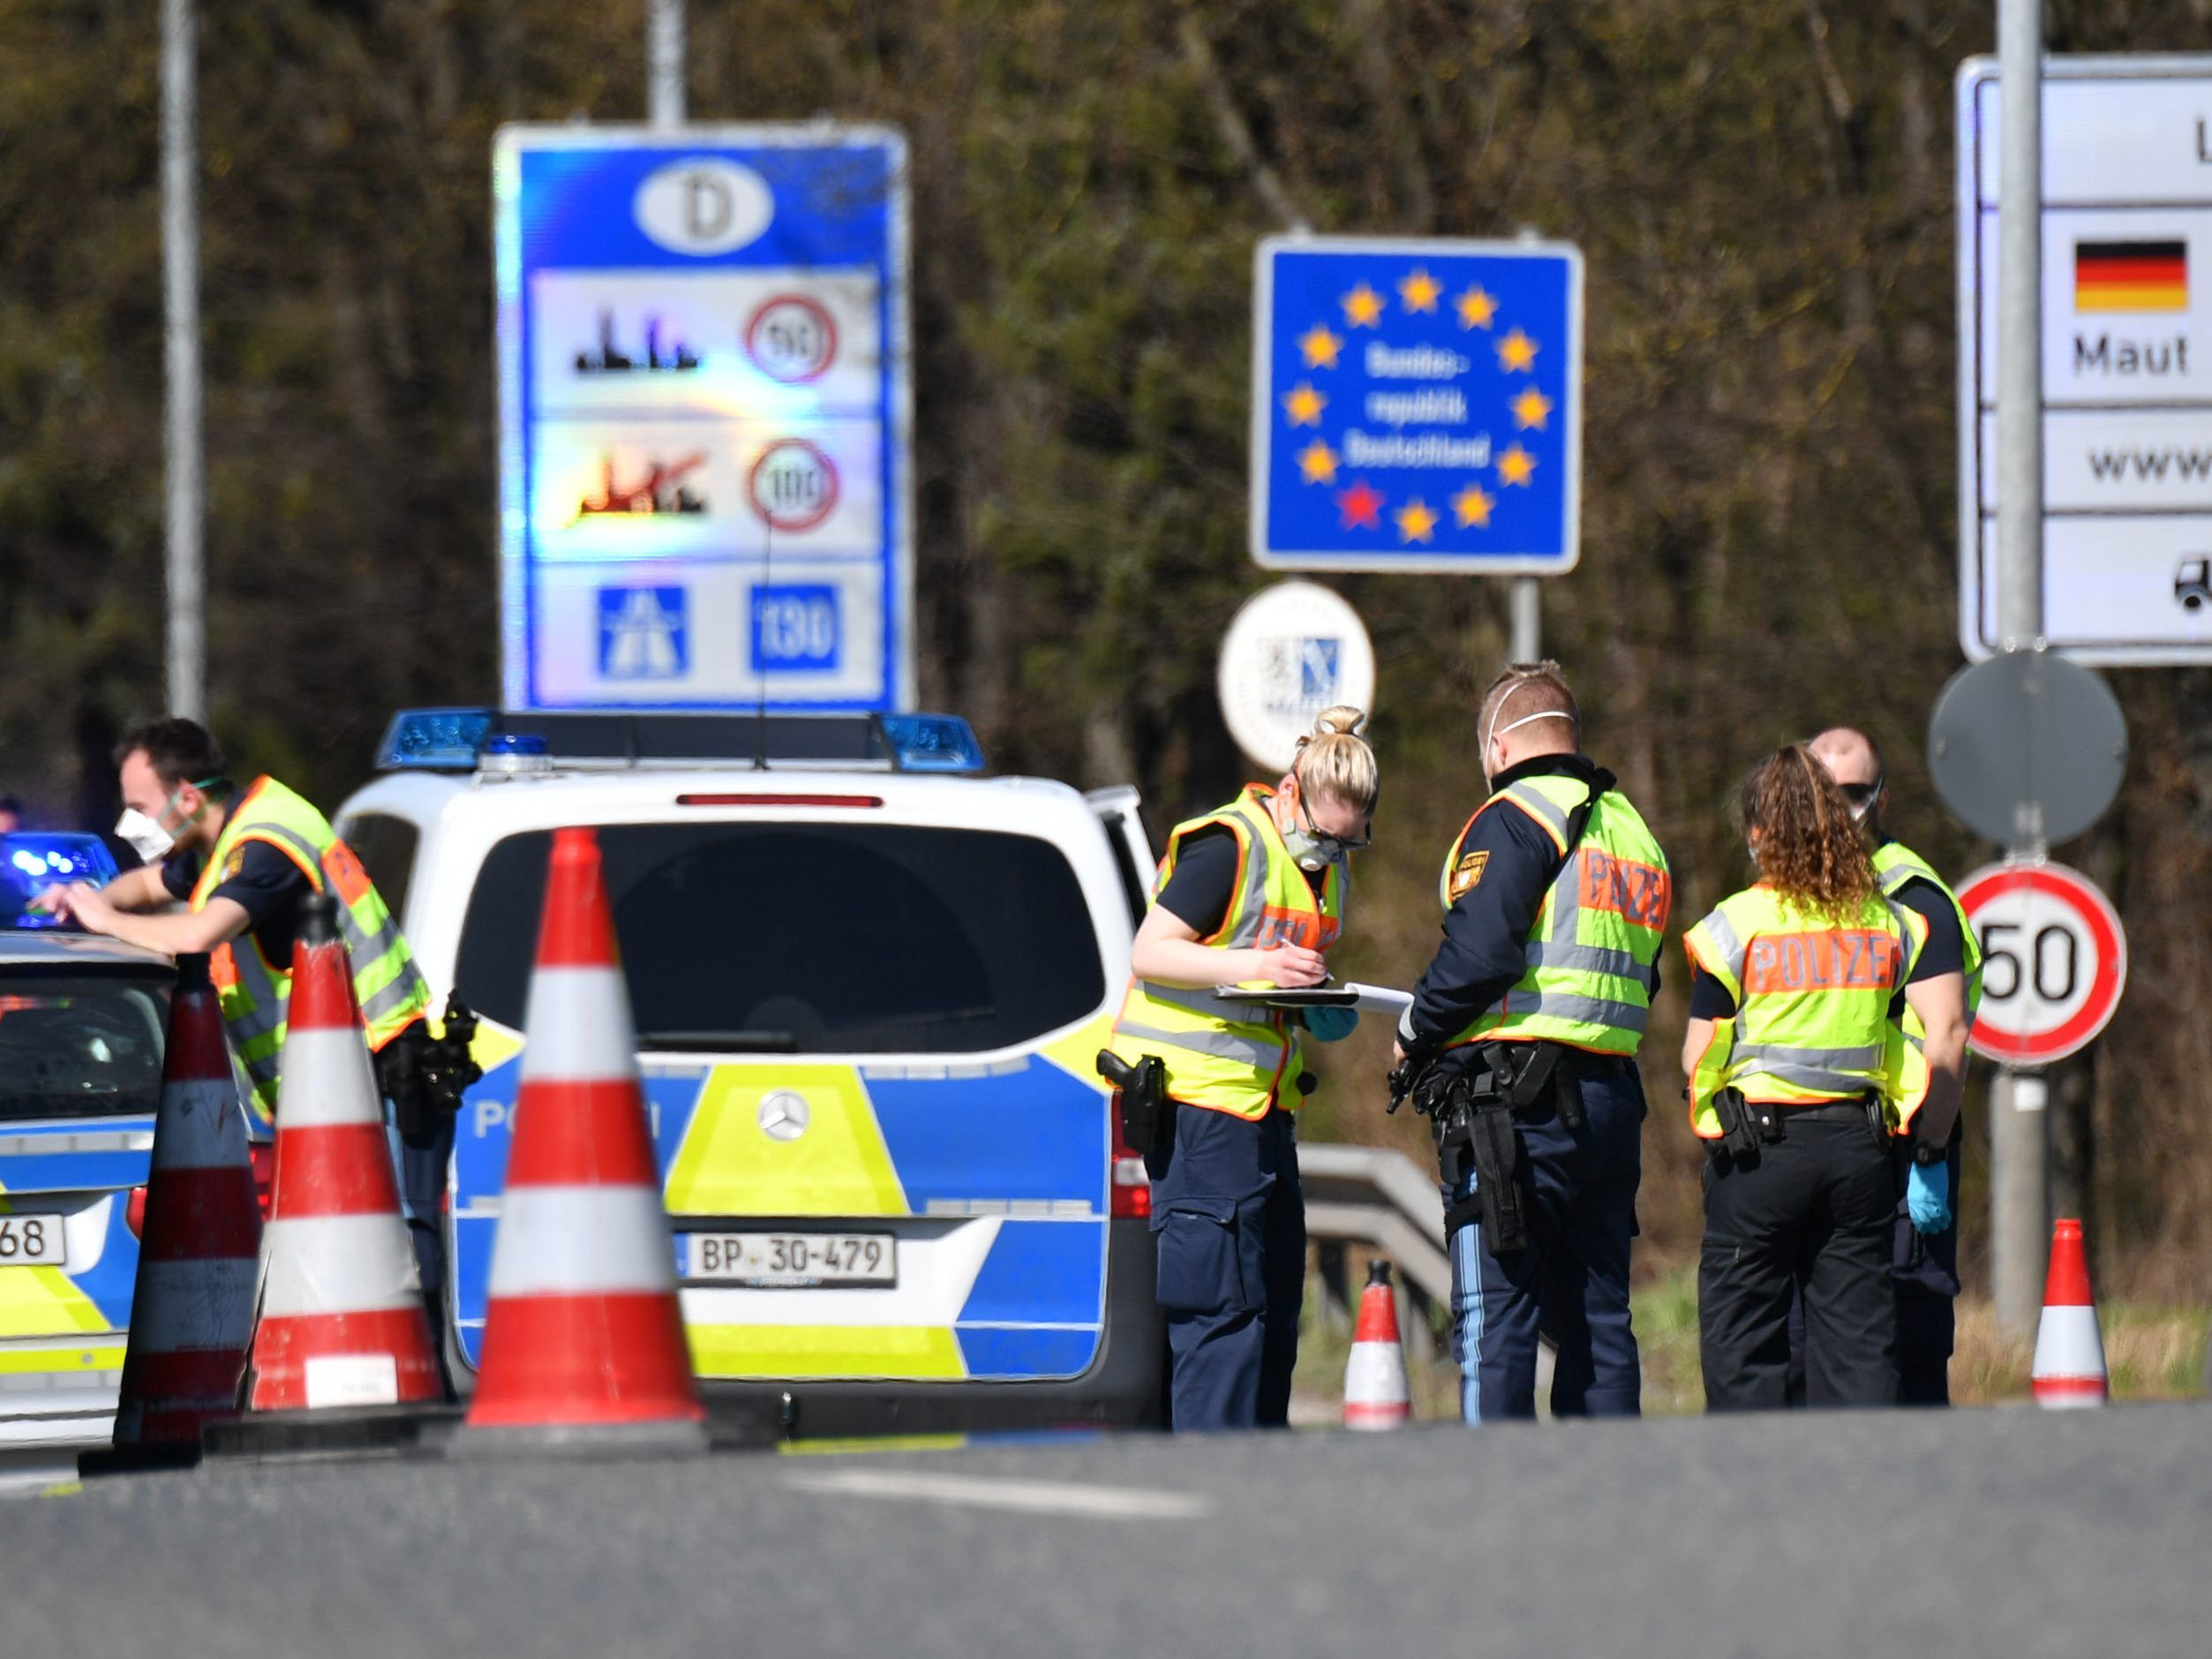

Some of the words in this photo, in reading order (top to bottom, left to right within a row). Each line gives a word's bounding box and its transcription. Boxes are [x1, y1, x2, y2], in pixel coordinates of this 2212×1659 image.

[683, 173, 732, 238] D
[2073, 332, 2187, 374] Maut
[1753, 935, 1889, 989] POLIZE
[1982, 924, 2075, 1000] 50
[0, 1220, 44, 1256] 68
[703, 1239, 741, 1271] BP
[769, 1239, 882, 1272] 30-479
